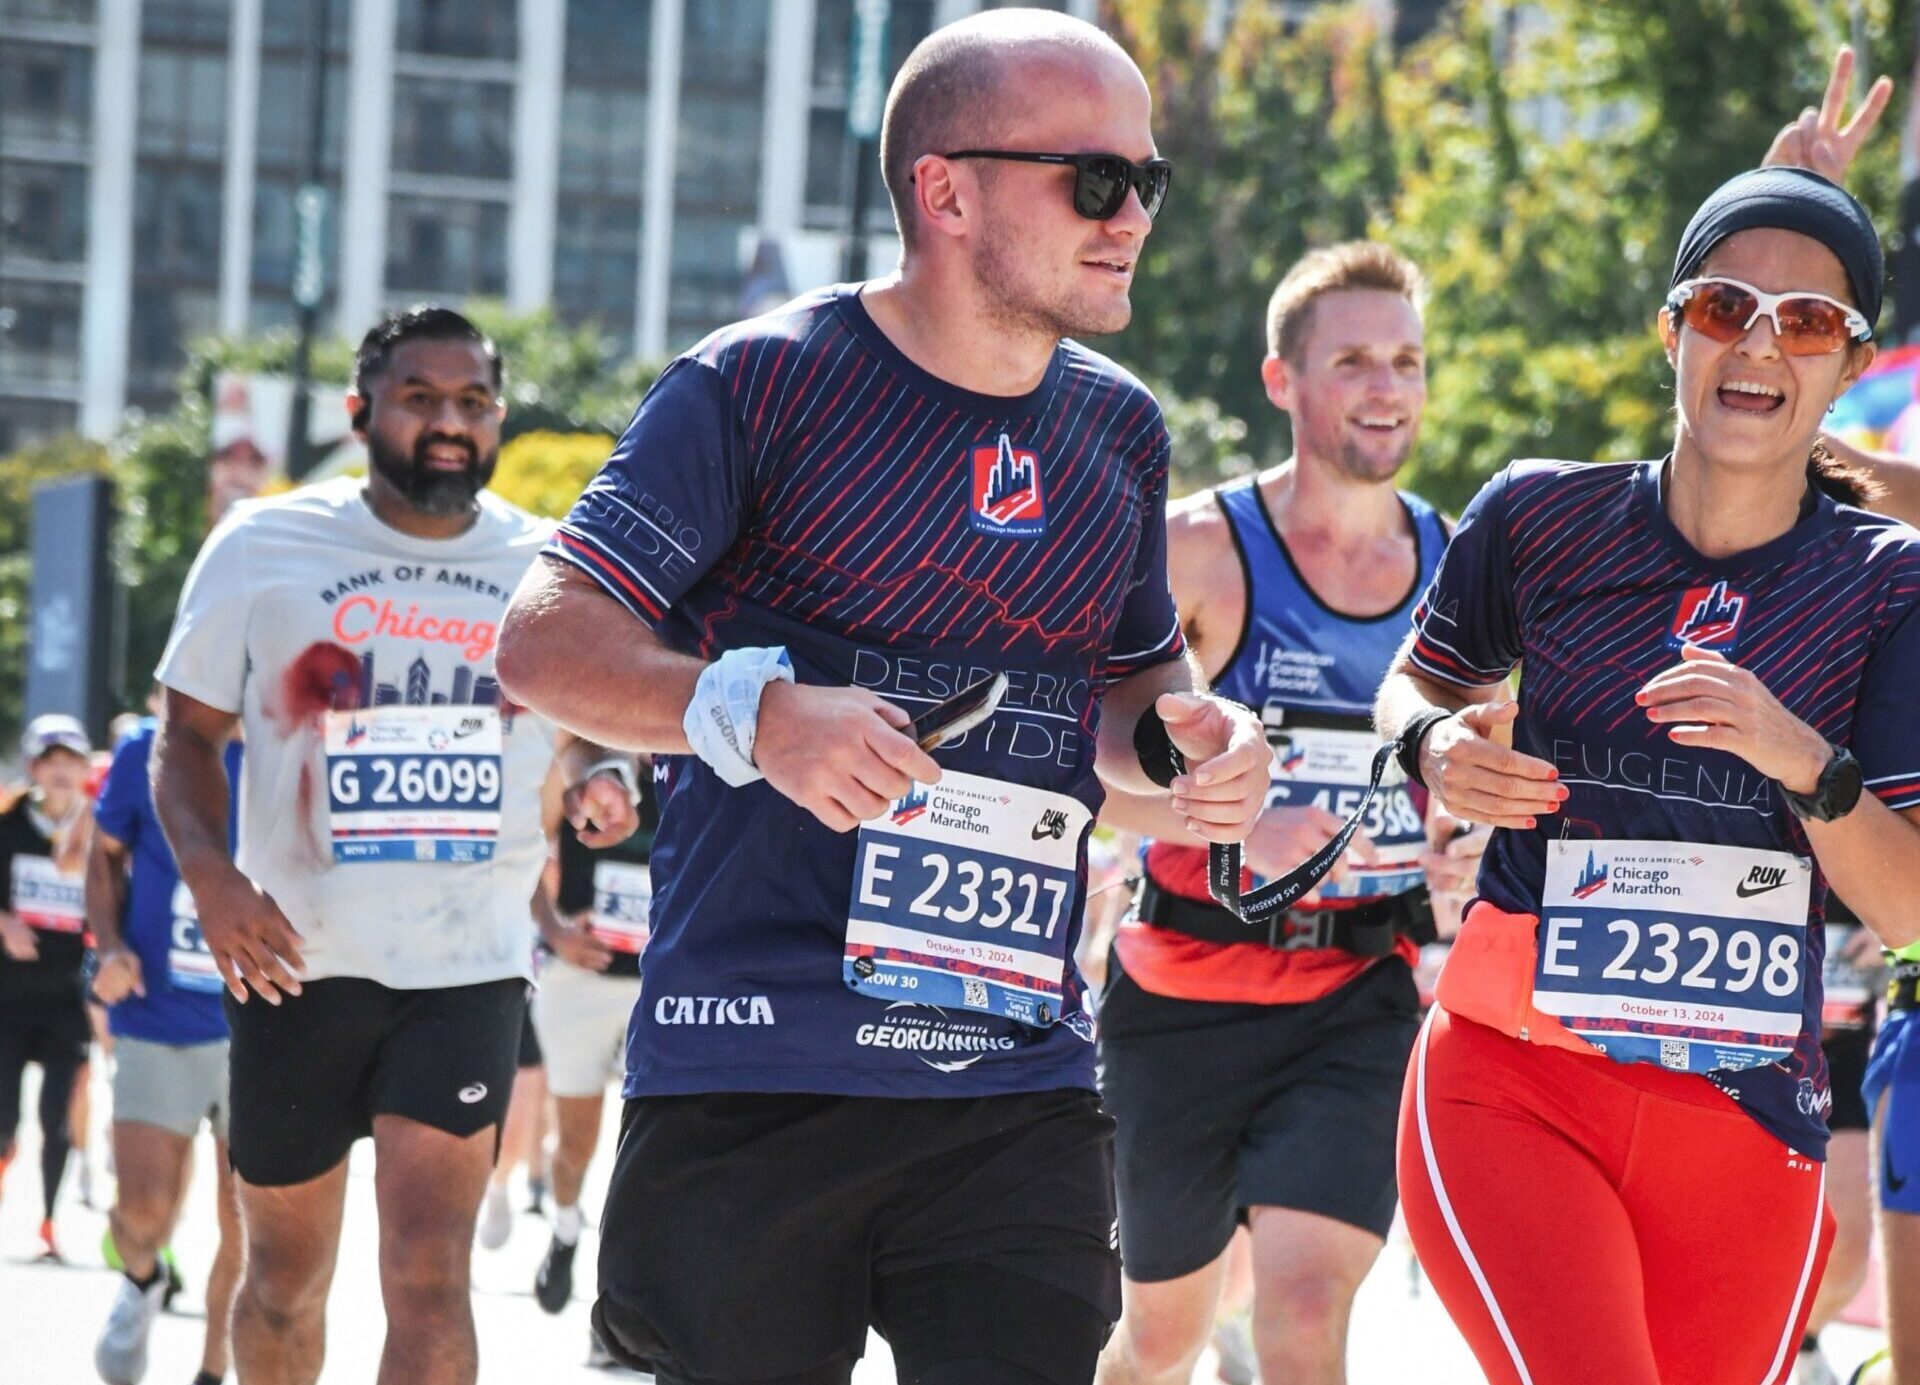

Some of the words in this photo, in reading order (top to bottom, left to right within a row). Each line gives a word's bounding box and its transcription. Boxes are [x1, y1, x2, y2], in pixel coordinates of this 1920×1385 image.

[320, 570, 385, 605] BANK
[395, 566, 425, 582] OF
[436, 569, 510, 603] AMERI
[332, 594, 498, 663] Chicag
[331, 760, 360, 804] G
[371, 758, 500, 804] 26099
[1554, 739, 1770, 809] EUGENIA
[935, 785, 955, 796] BANK
[956, 789, 966, 797] OF
[967, 792, 998, 803] AMERICA
[932, 796, 981, 819] Chicago
[1040, 808, 1069, 828] RUN
[930, 812, 990, 835] Marathon
[1650, 857, 1687, 865] AMERICA
[1613, 866, 1669, 883] Chicago
[1747, 865, 1787, 886] RUN
[859, 841, 901, 908] E
[909, 853, 1068, 940] 23327
[1612, 882, 1682, 897] Marathon
[926, 939, 965, 956] October
[970, 947, 986, 960] 13,
[988, 951, 1014, 965] 2024
[1543, 917, 1583, 977] E
[1602, 919, 1800, 997] 23298
[900, 976, 918, 989] 30
[655, 996, 775, 1025] CATICA
[1621, 1002, 1669, 1018] October
[1673, 1008, 1690, 1020] 13,
[1694, 1010, 1725, 1023] 2024
[884, 1015, 899, 1025] LA
[901, 1017, 932, 1028] FORMA
[934, 1020, 947, 1029] SI
[949, 1023, 988, 1034] IMPORTA
[856, 1024, 1015, 1051] GEORUNNING
[1787, 1160, 1813, 1172] AIR
